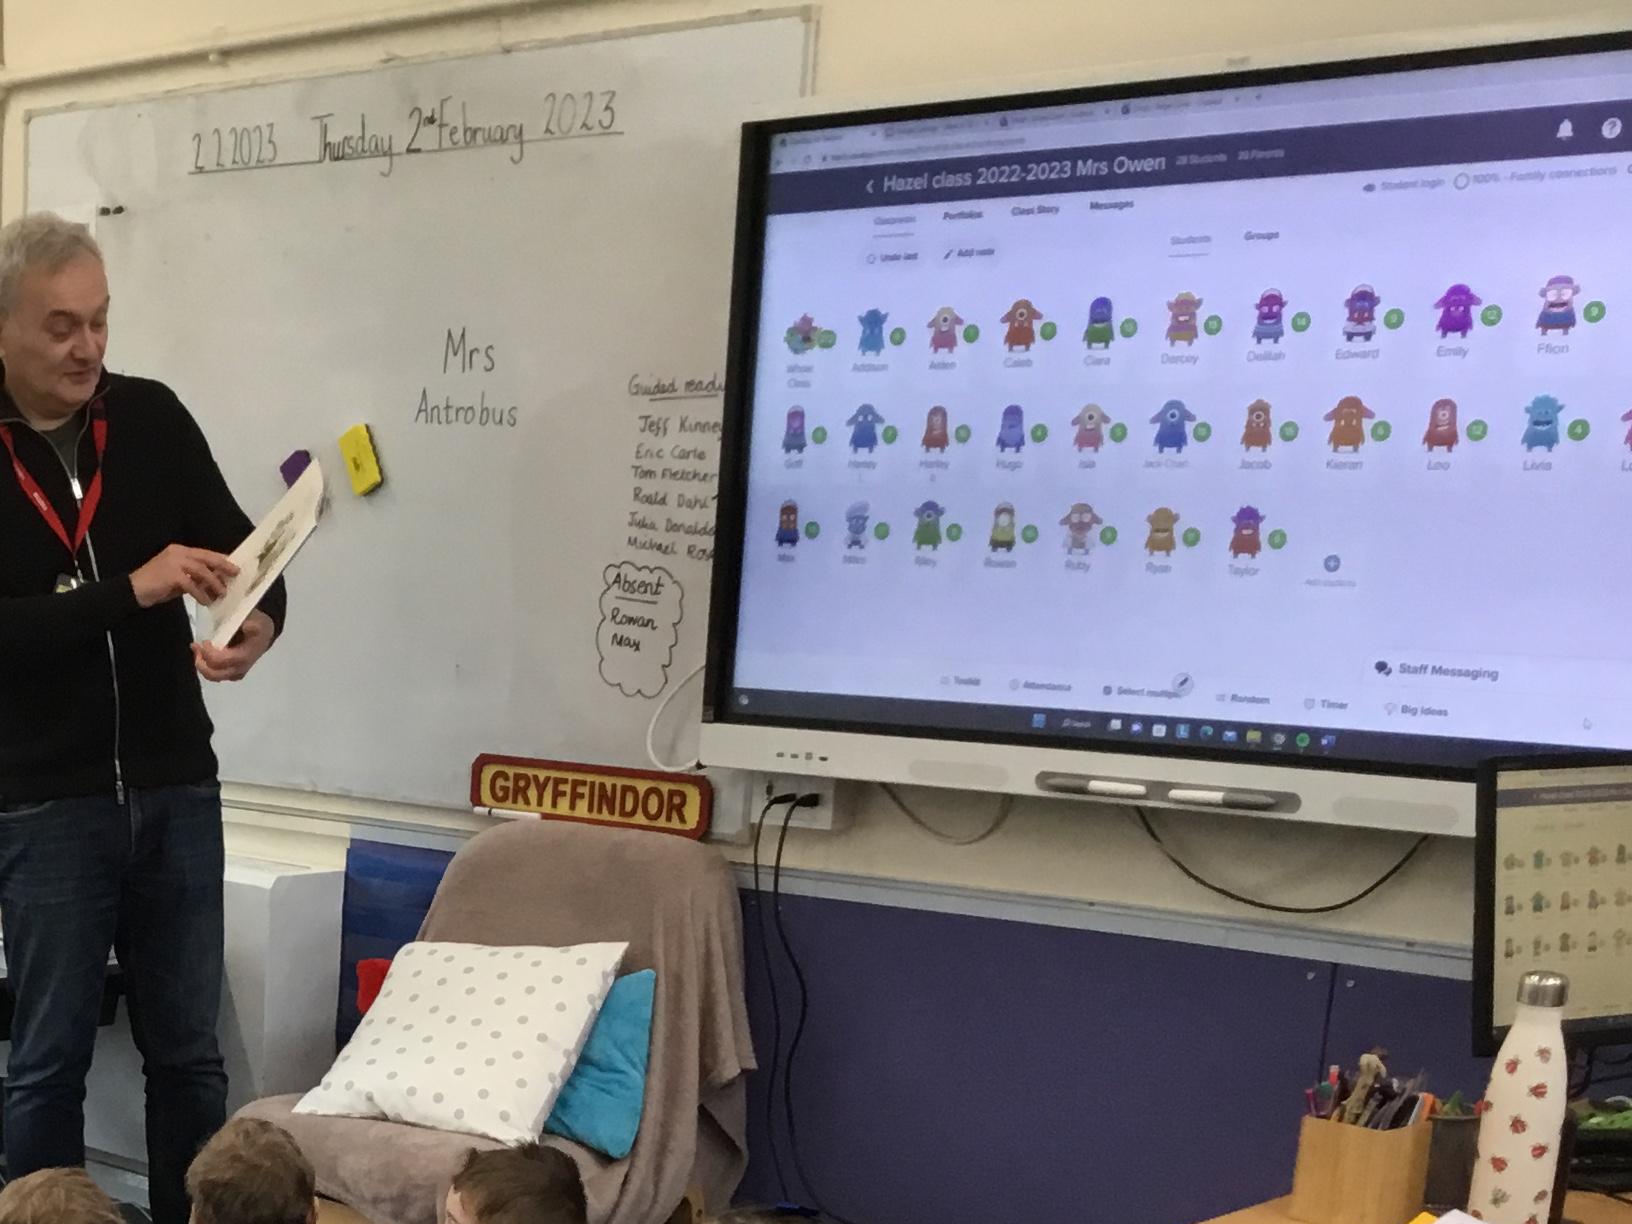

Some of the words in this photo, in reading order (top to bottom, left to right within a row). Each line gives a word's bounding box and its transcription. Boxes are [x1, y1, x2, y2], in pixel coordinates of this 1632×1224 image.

[310, 112, 394, 177] Thursday
[437, 95, 524, 165] February
[543, 90, 617, 135] 2023
[883, 173, 928, 192] Hazel
[931, 171, 972, 189] class
[976, 161, 1072, 185] 2022-2023
[1076, 159, 1109, 177] Mrs
[1113, 155, 1167, 174] Owen
[442, 326, 496, 374] Mrs
[1436, 345, 1470, 359] Emily
[628, 373, 678, 396] Guided
[413, 387, 518, 428] Antrobus
[638, 415, 670, 437] Jeff
[635, 442, 664, 460] Eric
[631, 464, 657, 480] Tom
[632, 486, 668, 506] Roald
[610, 572, 665, 596] Absent
[610, 606, 659, 631] Rowan
[1398, 662, 1429, 677] Staff
[1430, 664, 1499, 682] Messaging
[1320, 699, 1349, 711] Timer
[489, 769, 688, 825] GRYFFINDOR
